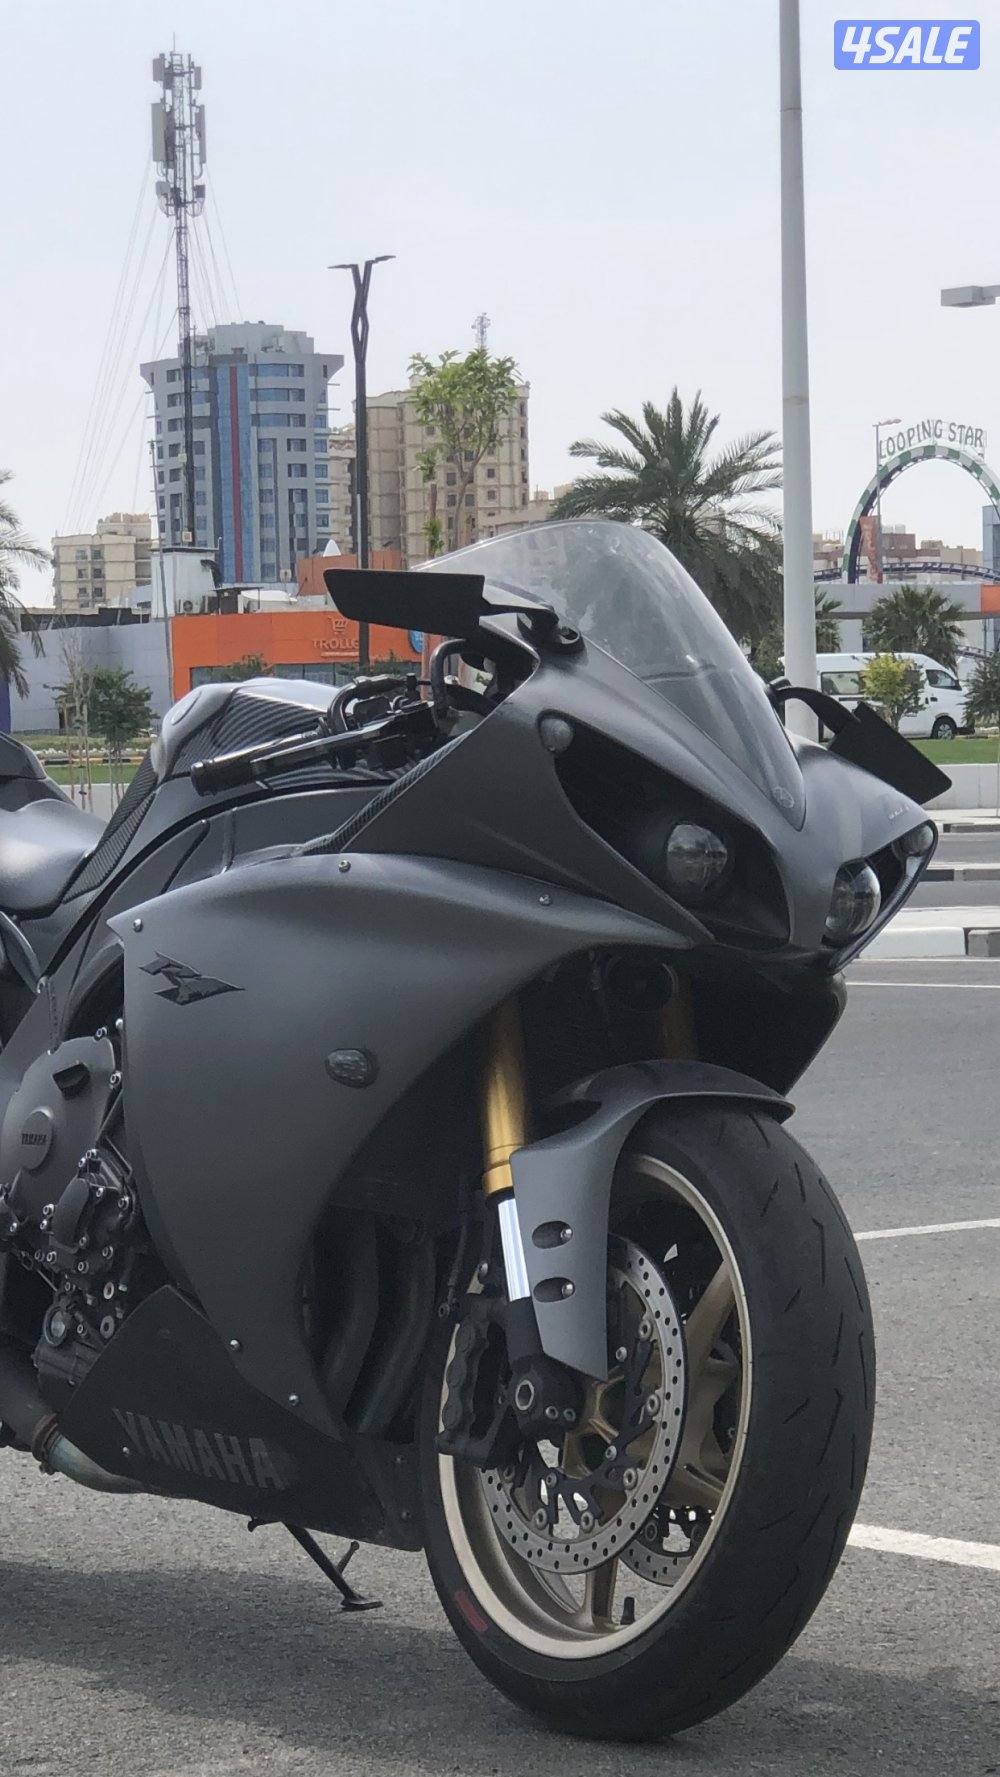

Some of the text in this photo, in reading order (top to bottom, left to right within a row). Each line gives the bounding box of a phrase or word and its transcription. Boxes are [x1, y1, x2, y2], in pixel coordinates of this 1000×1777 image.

[880, 419, 984, 459] LOOPING STAR
[313, 638, 360, 650] TROLLE
[112, 1407, 287, 1490] YAMAHA
